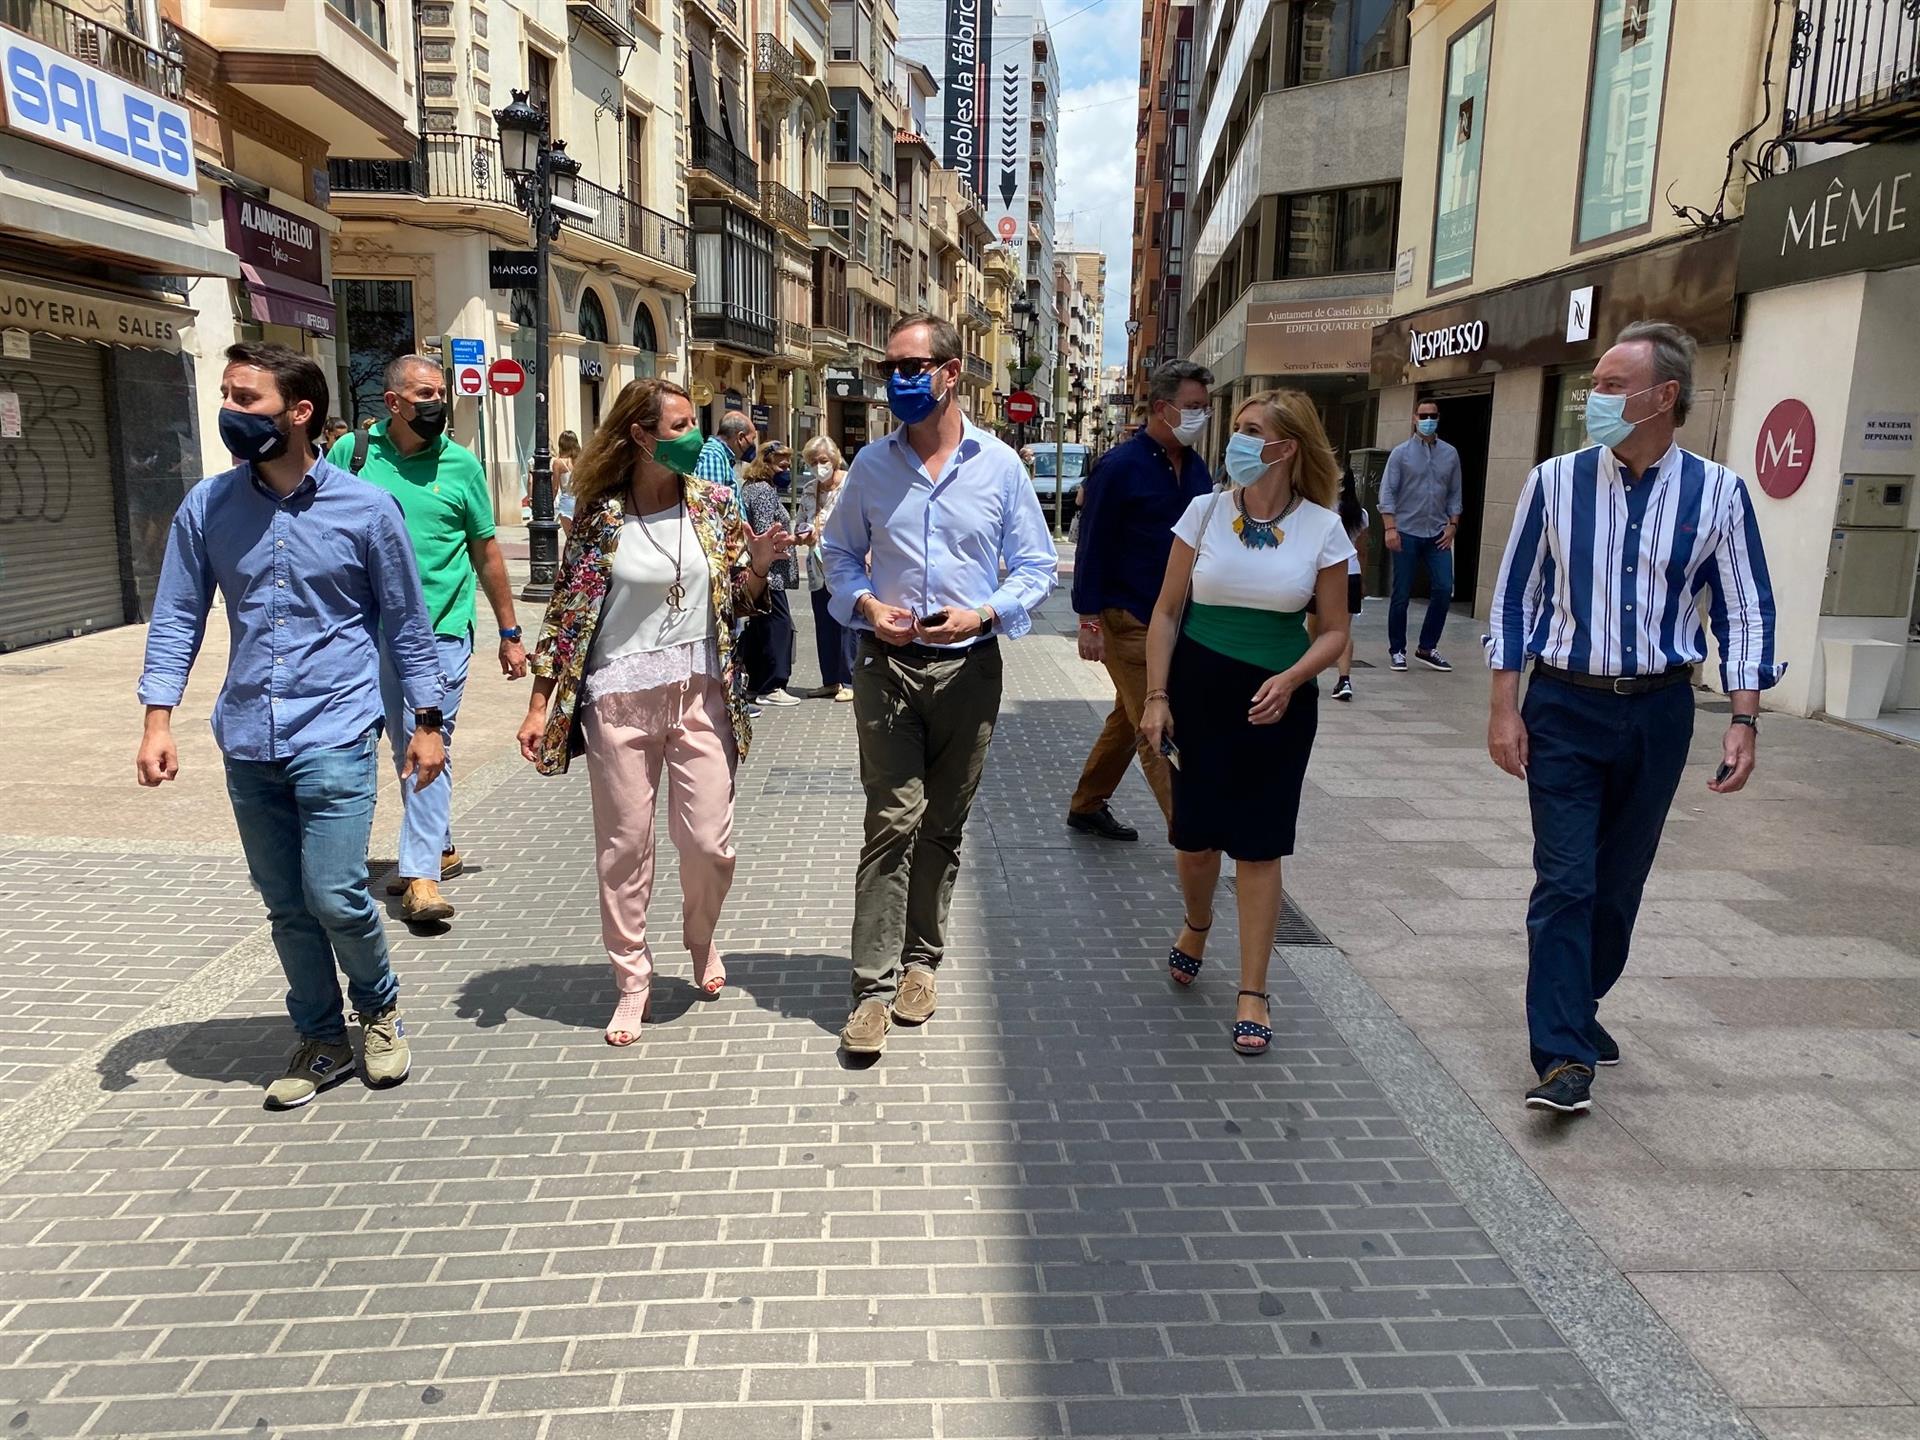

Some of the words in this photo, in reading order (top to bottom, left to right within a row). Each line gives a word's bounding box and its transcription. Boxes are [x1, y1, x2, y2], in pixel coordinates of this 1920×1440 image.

[951, 72, 973, 91] la
[7, 46, 190, 177] SALES
[1780, 172, 1912, 256] MÊME
[1001, 237, 1023, 247] Aquí
[492, 265, 538, 275] MANGO
[0, 295, 100, 329] JOYERIA
[118, 315, 173, 340] SALES
[1267, 309, 1313, 322] Ajuntament
[1314, 308, 1325, 317] de
[1326, 305, 1361, 317] Castelló
[1363, 305, 1374, 315] de
[1376, 304, 1384, 314] la
[1286, 323, 1319, 334] EDIFICI
[1321, 321, 1360, 332] QUATRE
[1573, 300, 1586, 330] N
[1409, 320, 1484, 368] NESPRESSO
[1760, 428, 1803, 474] ME
